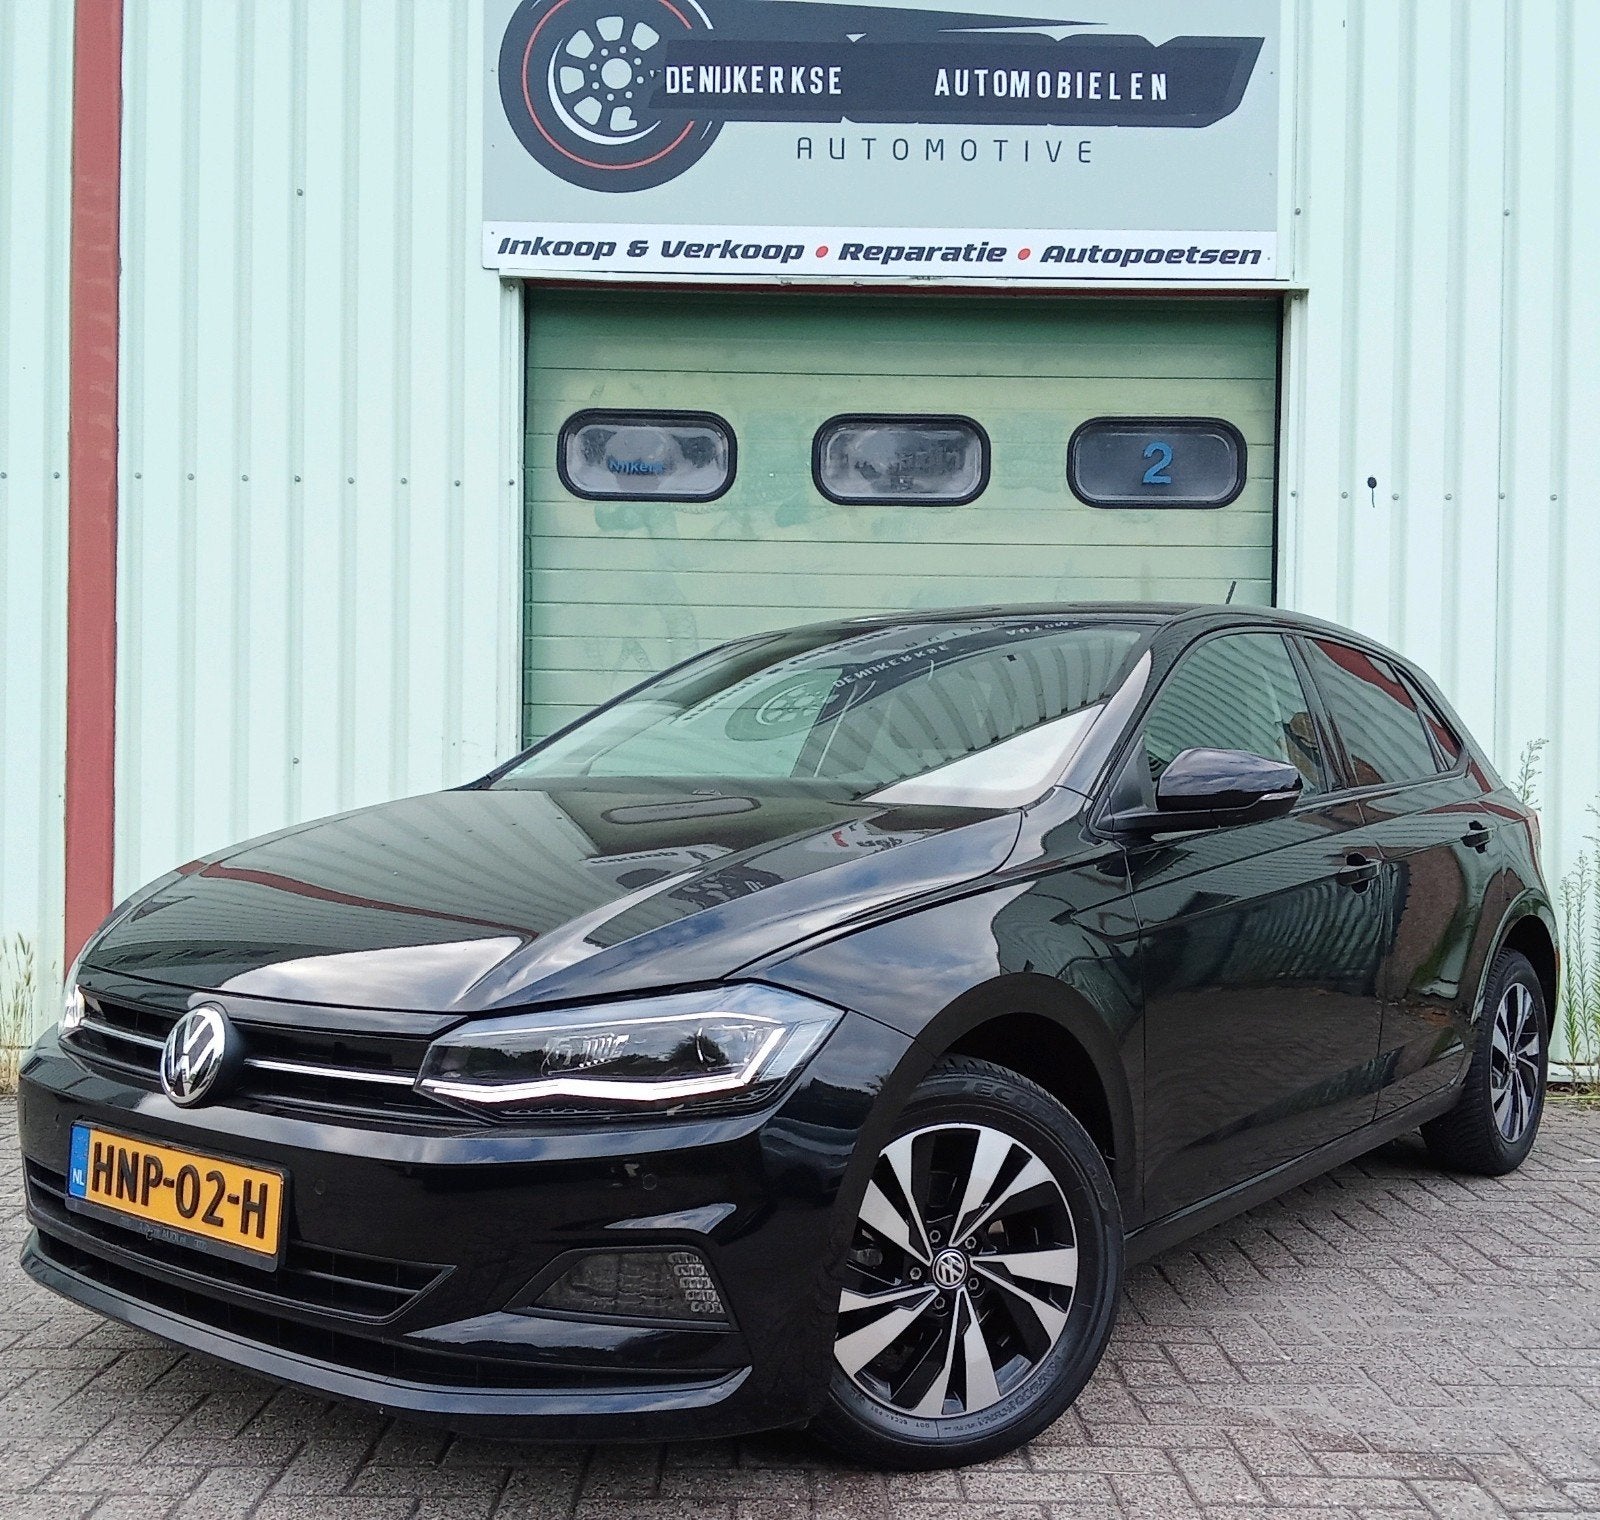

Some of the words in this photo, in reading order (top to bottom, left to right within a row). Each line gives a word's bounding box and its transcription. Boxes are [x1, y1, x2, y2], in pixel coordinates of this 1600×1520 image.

[934, 68, 1168, 101] AUTOMOBIELEN
[797, 136, 1092, 164] AUTOMOTIVE
[497, 236, 617, 261] Inkoop
[626, 239, 649, 258] &
[660, 239, 806, 264] Verkoop
[838, 241, 1007, 265] Reparatie
[1040, 245, 1262, 268] Autopoetsen
[1142, 441, 1174, 484] 2
[72, 1168, 85, 1187] NL
[91, 1141, 269, 1240] HNP-02-H
